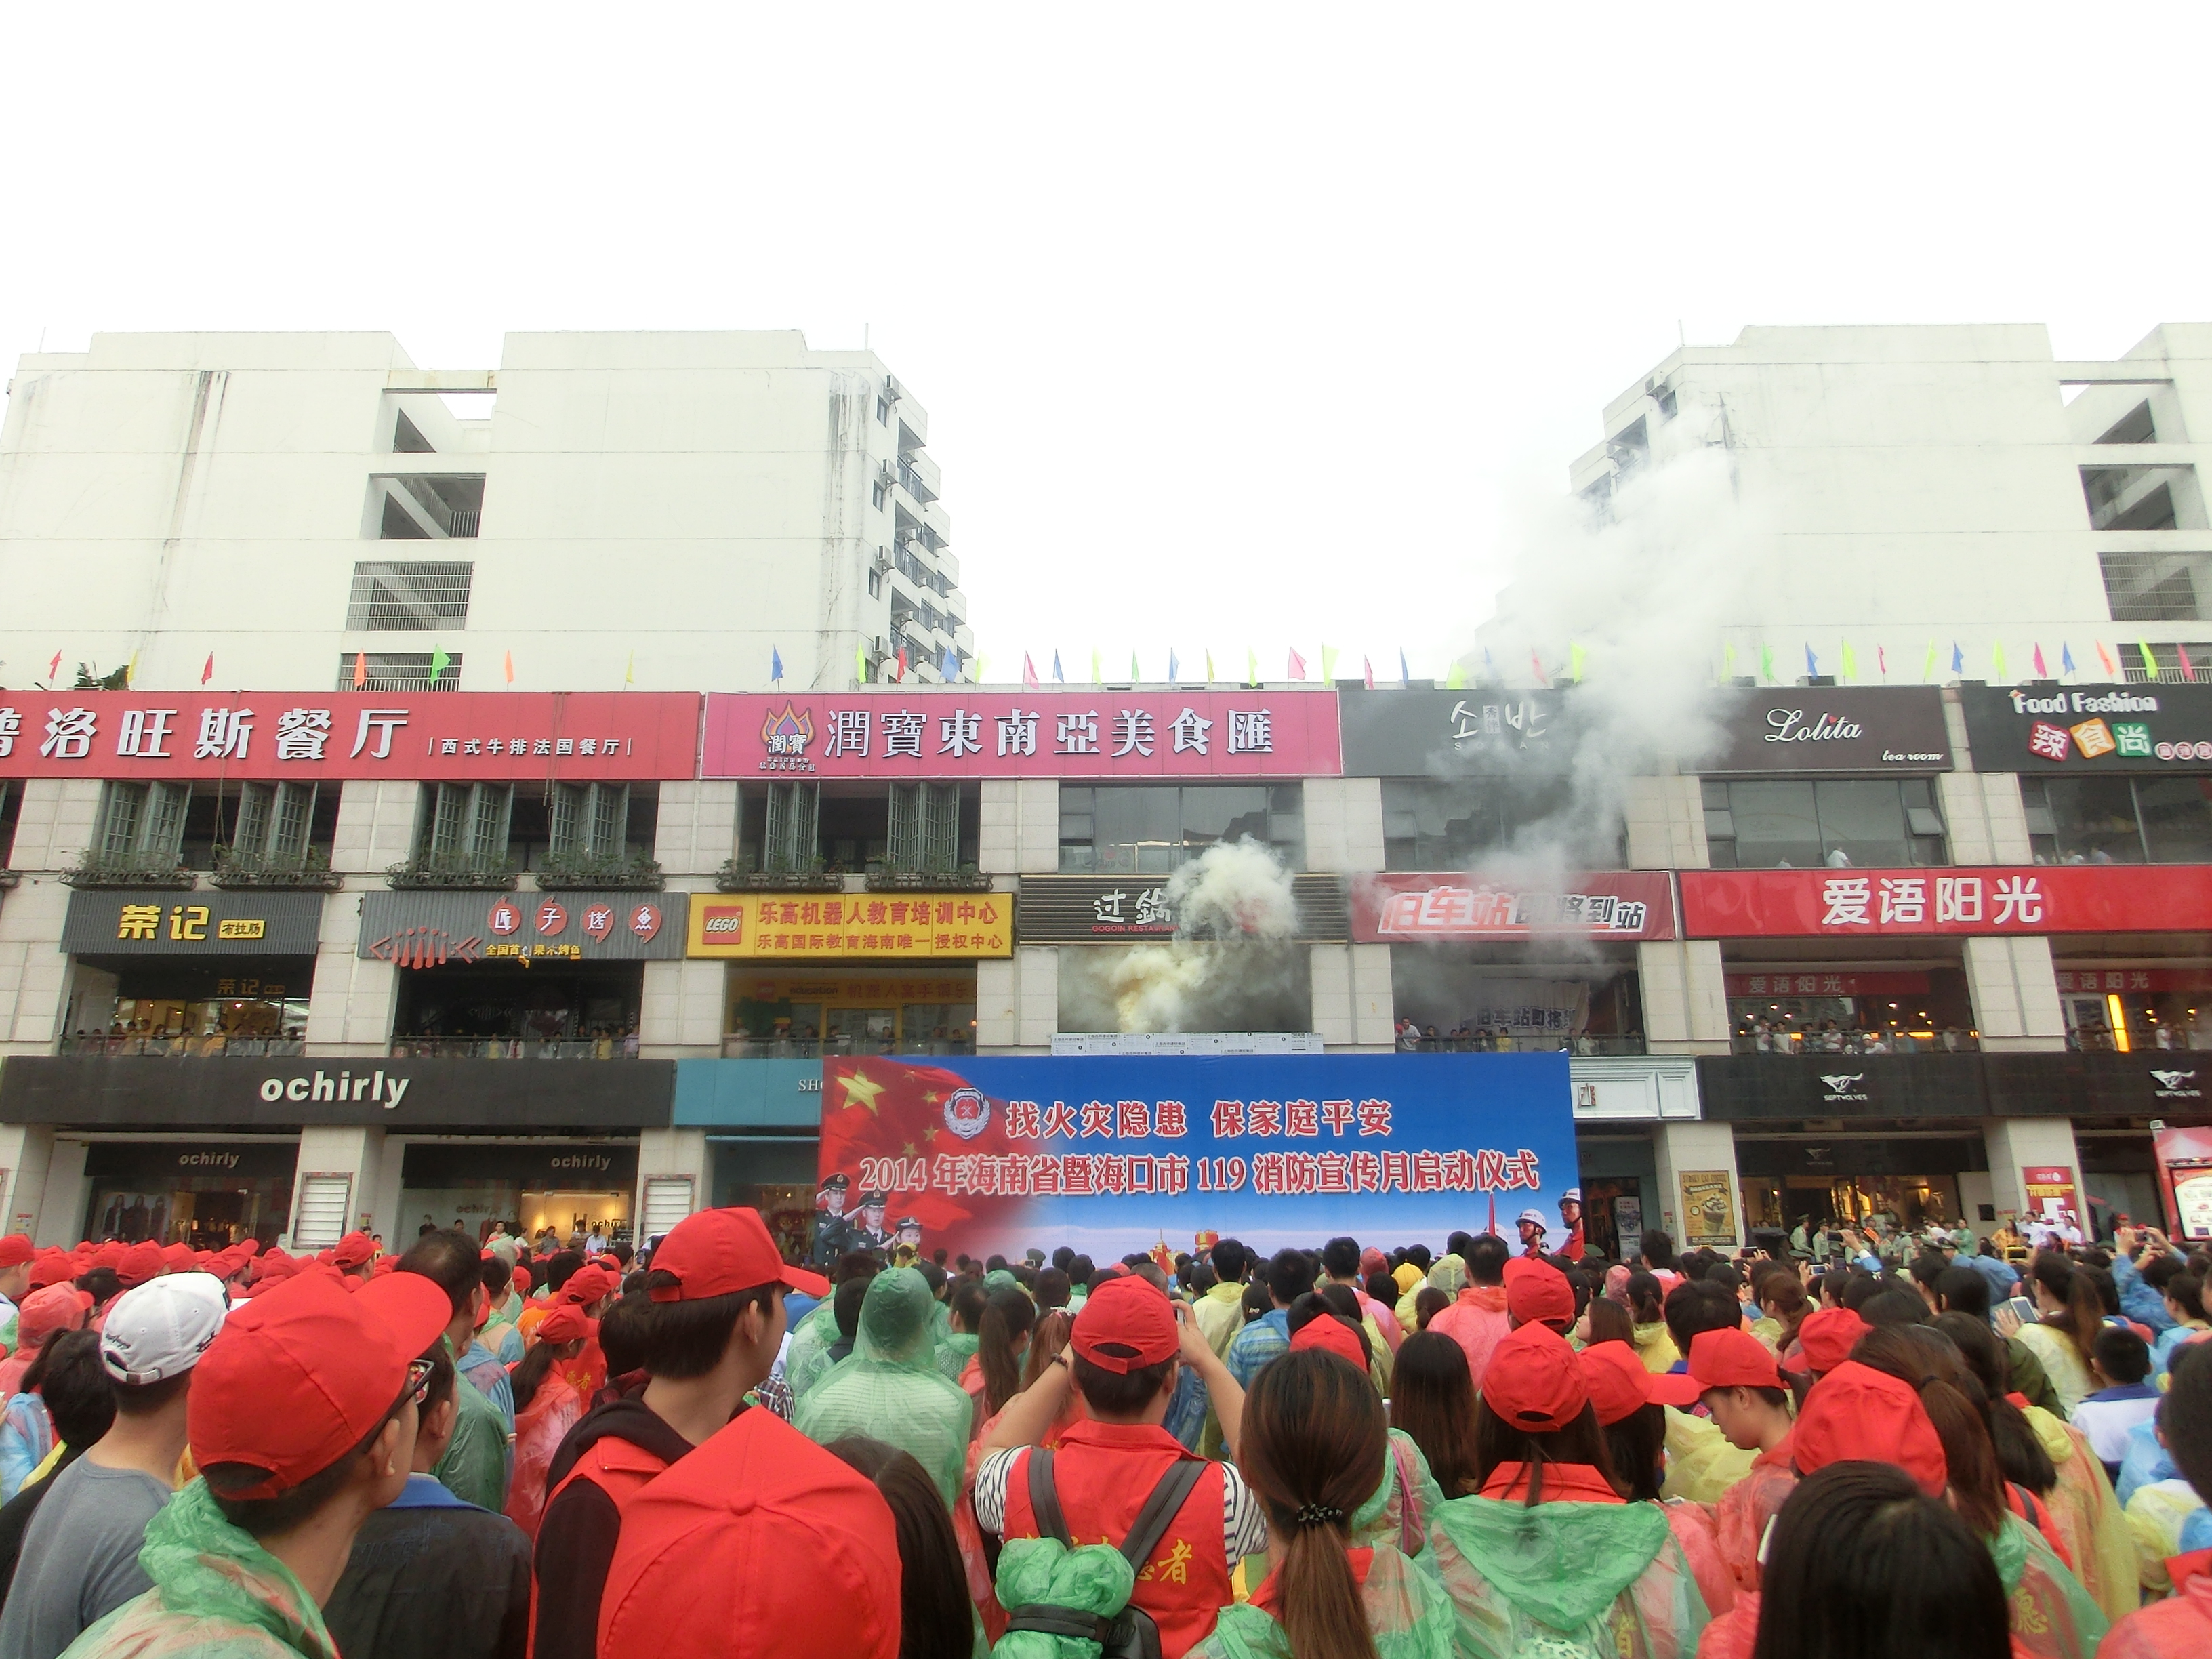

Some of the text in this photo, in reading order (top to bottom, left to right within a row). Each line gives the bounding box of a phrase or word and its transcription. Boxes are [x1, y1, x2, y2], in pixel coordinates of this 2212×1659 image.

[2014, 692, 2158, 714] Food Fashion
[823, 707, 1273, 758] 潤寶東南亞美食匯
[1764, 707, 1862, 743] Lolita
[441, 737, 620, 756] 西式牛排法国餐厅
[767, 734, 807, 754] 潤寶
[2032, 722, 2148, 758] 辣食尚
[1881, 749, 1944, 762] tea room
[1822, 875, 2043, 926] 爱语阳光
[117, 905, 210, 941] 荣记
[758, 901, 999, 926] 乐高机器人教育培训中心
[705, 917, 740, 933] LEGO
[756, 933, 1003, 949] 乐高国际教育海南唯一授权中心
[1748, 975, 1842, 994] 爱语阳光
[260, 1070, 409, 1109] ochirly
[1006, 1098, 1393, 1139] 找火灾隐患 保家庭平安
[179, 1151, 240, 1169] ochirly
[551, 1155, 611, 1171] ochirly
